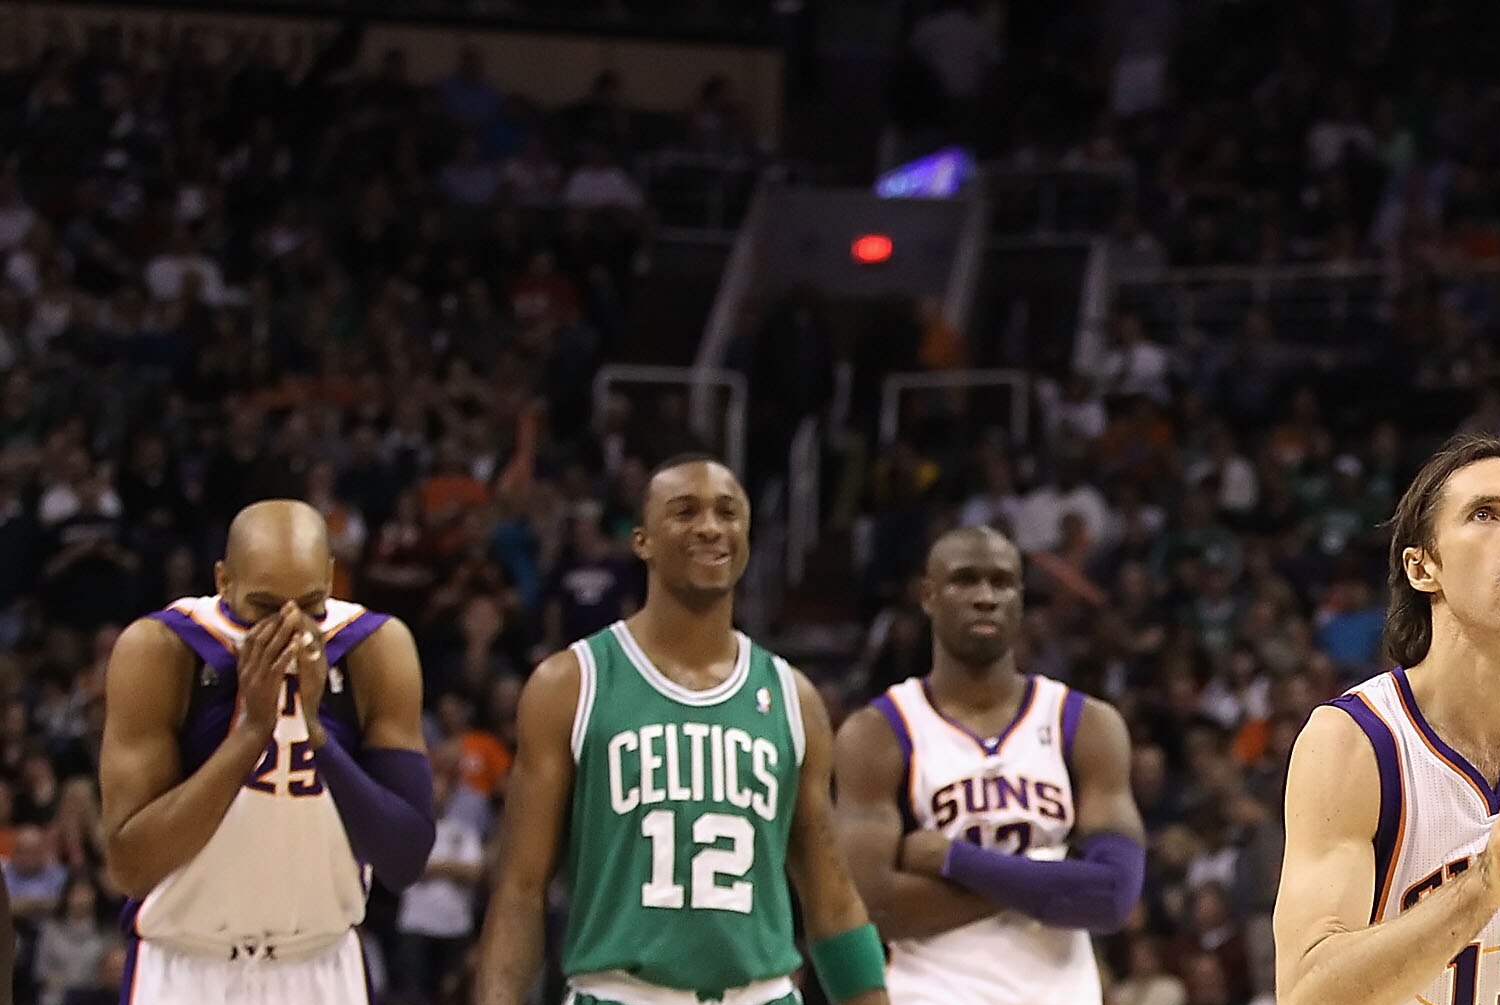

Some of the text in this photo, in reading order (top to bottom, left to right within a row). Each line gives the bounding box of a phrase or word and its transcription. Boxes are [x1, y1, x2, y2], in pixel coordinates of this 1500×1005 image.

[608, 722, 779, 821] CELTICS
[931, 776, 1067, 830] SUNS
[641, 809, 755, 914] 12
